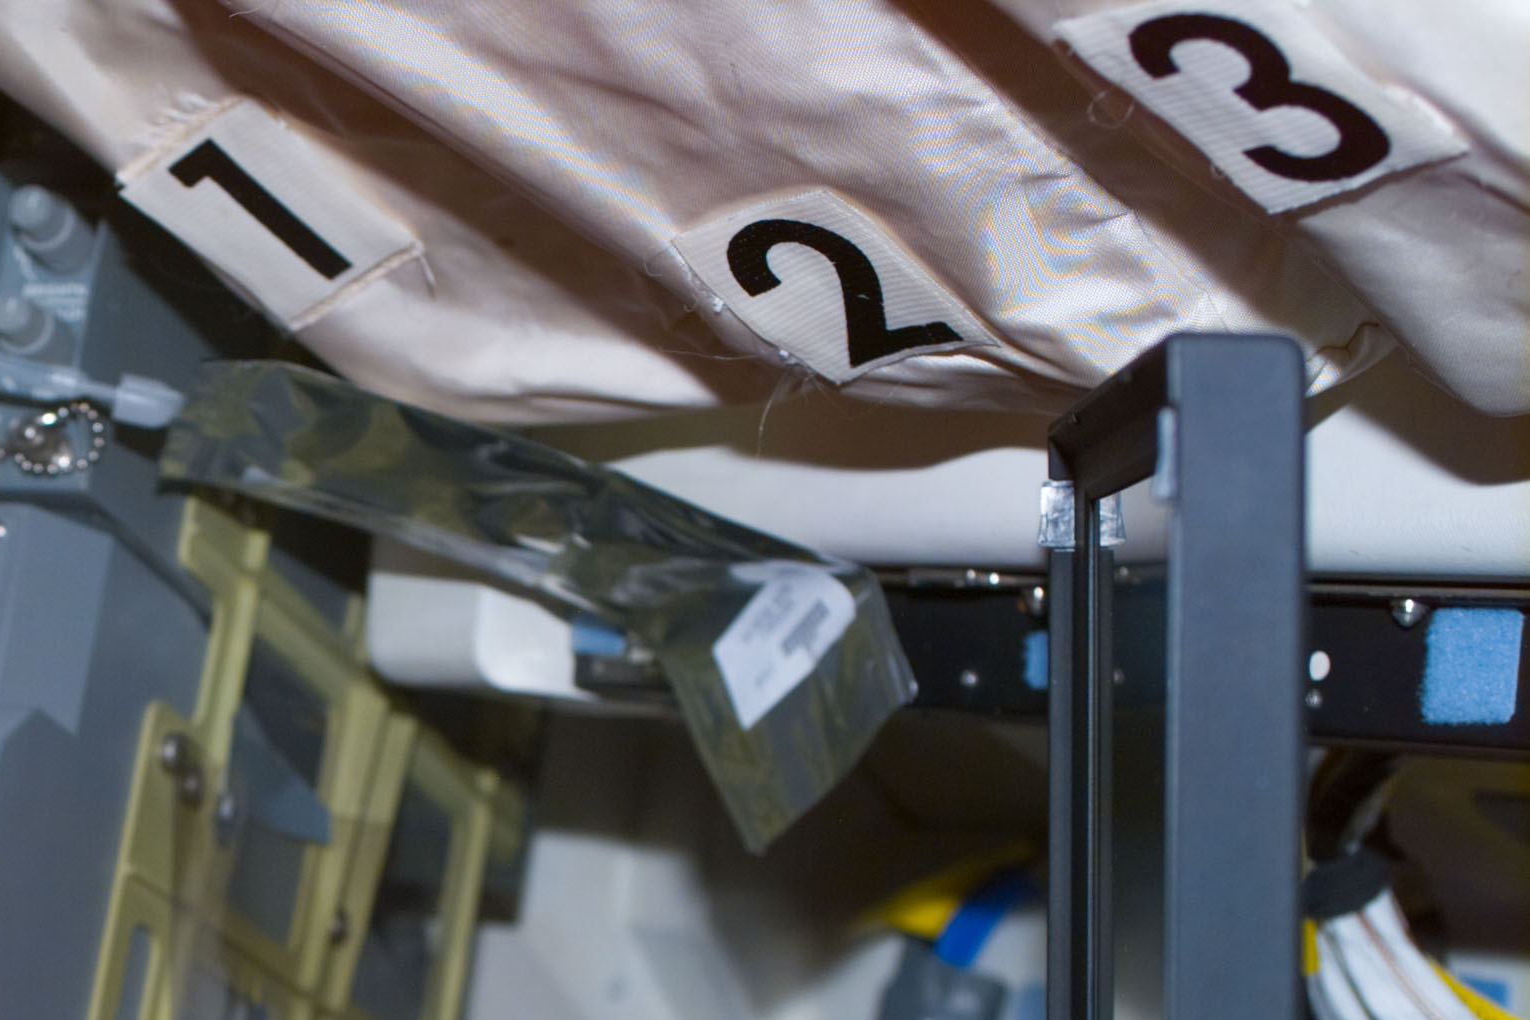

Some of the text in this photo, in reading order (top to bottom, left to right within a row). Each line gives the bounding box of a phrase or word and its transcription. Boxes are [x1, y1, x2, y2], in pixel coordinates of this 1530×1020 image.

[1128, 13, 1391, 182] 3
[167, 137, 352, 280] 1
[725, 217, 963, 368] 2
